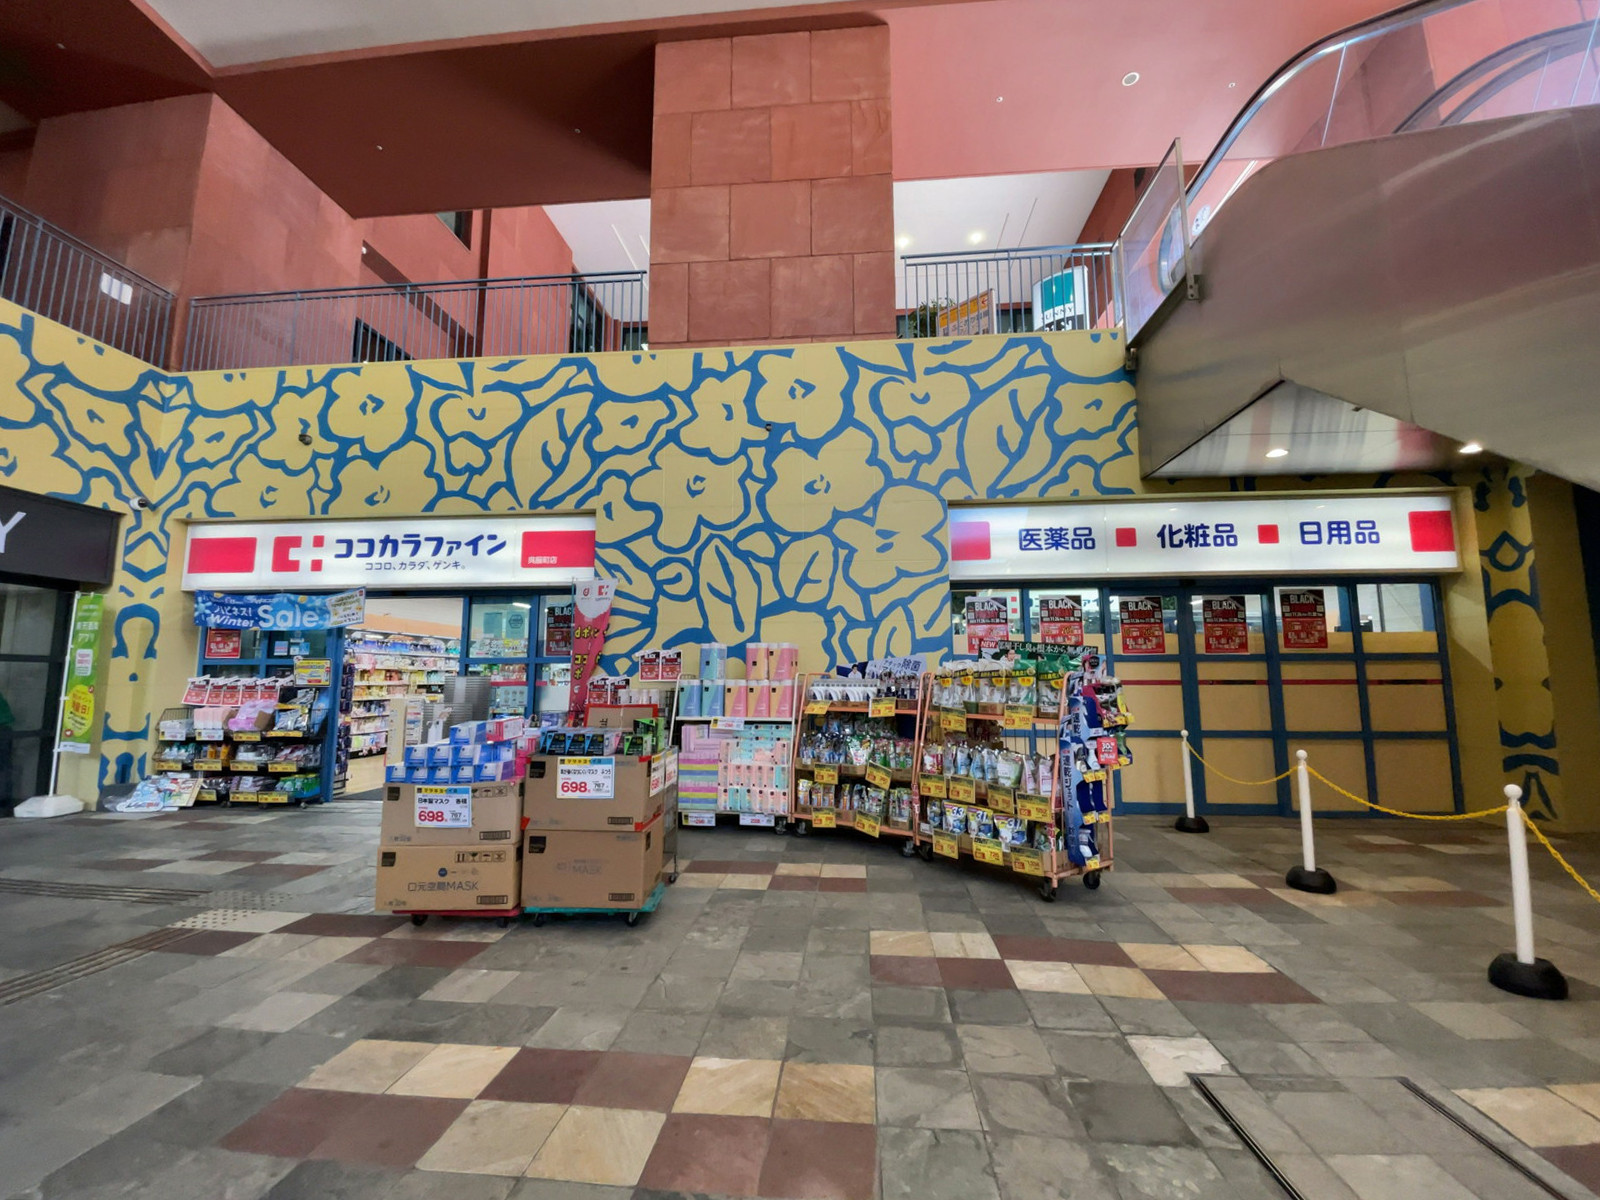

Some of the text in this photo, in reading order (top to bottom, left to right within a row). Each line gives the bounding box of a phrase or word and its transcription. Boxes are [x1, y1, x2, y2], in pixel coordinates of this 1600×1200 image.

[1018, 526, 1096, 551] 医薬品
[1156, 522, 1238, 549] 化粧品
[1299, 520, 1381, 545] 日用品
[334, 533, 507, 559] ココカラファイン
[975, 602, 998, 611] BLACK
[1048, 600, 1073, 609] BLACK
[1128, 601, 1153, 611] BLACK
[1211, 600, 1237, 610] BLACK
[210, 613, 255, 627] Winter
[257, 603, 320, 629] Sale
[554, 606, 572, 617] BLAC
[980, 641, 997, 650] NEW
[561, 781, 588, 793] 698
[418, 810, 445, 822] 698
